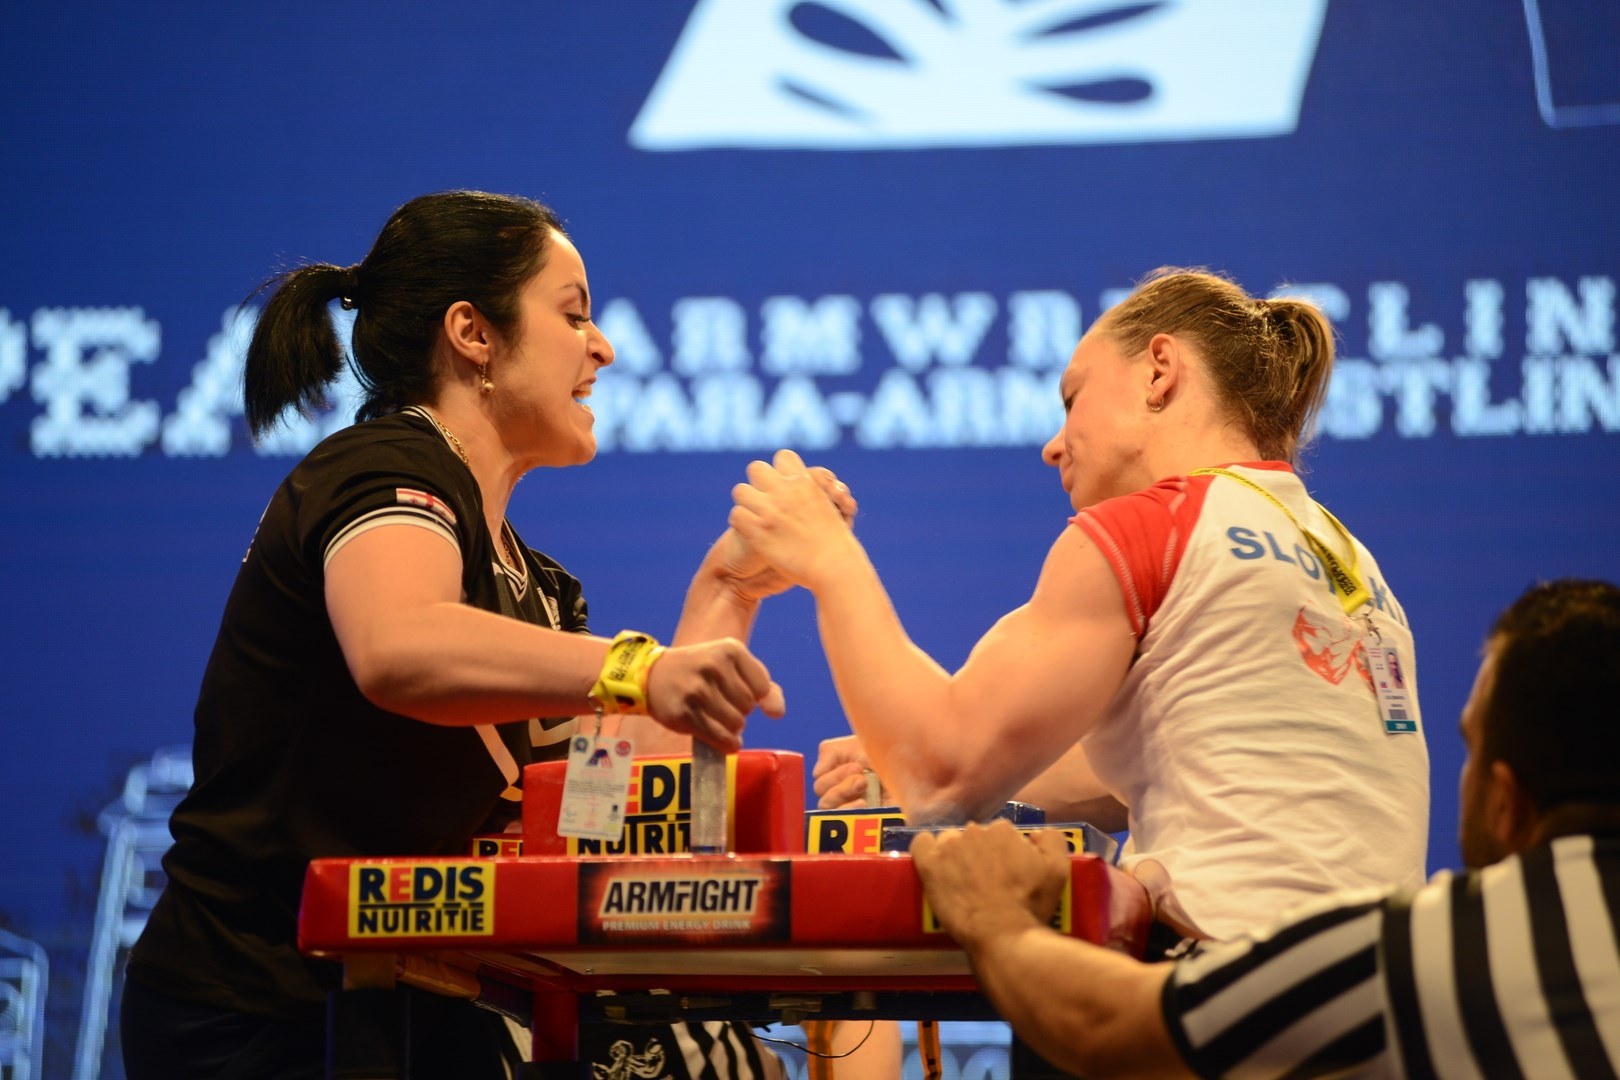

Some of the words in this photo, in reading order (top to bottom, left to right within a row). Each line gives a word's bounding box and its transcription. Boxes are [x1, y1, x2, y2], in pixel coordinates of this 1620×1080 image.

[359, 866, 484, 902] REDIS
[602, 878, 760, 914] ARMFIGHT
[358, 907, 484, 933] NUTRITIE
[602, 920, 659, 932] PREMIUM
[663, 919, 708, 931] ENERGY
[712, 919, 751, 930] DRINK
